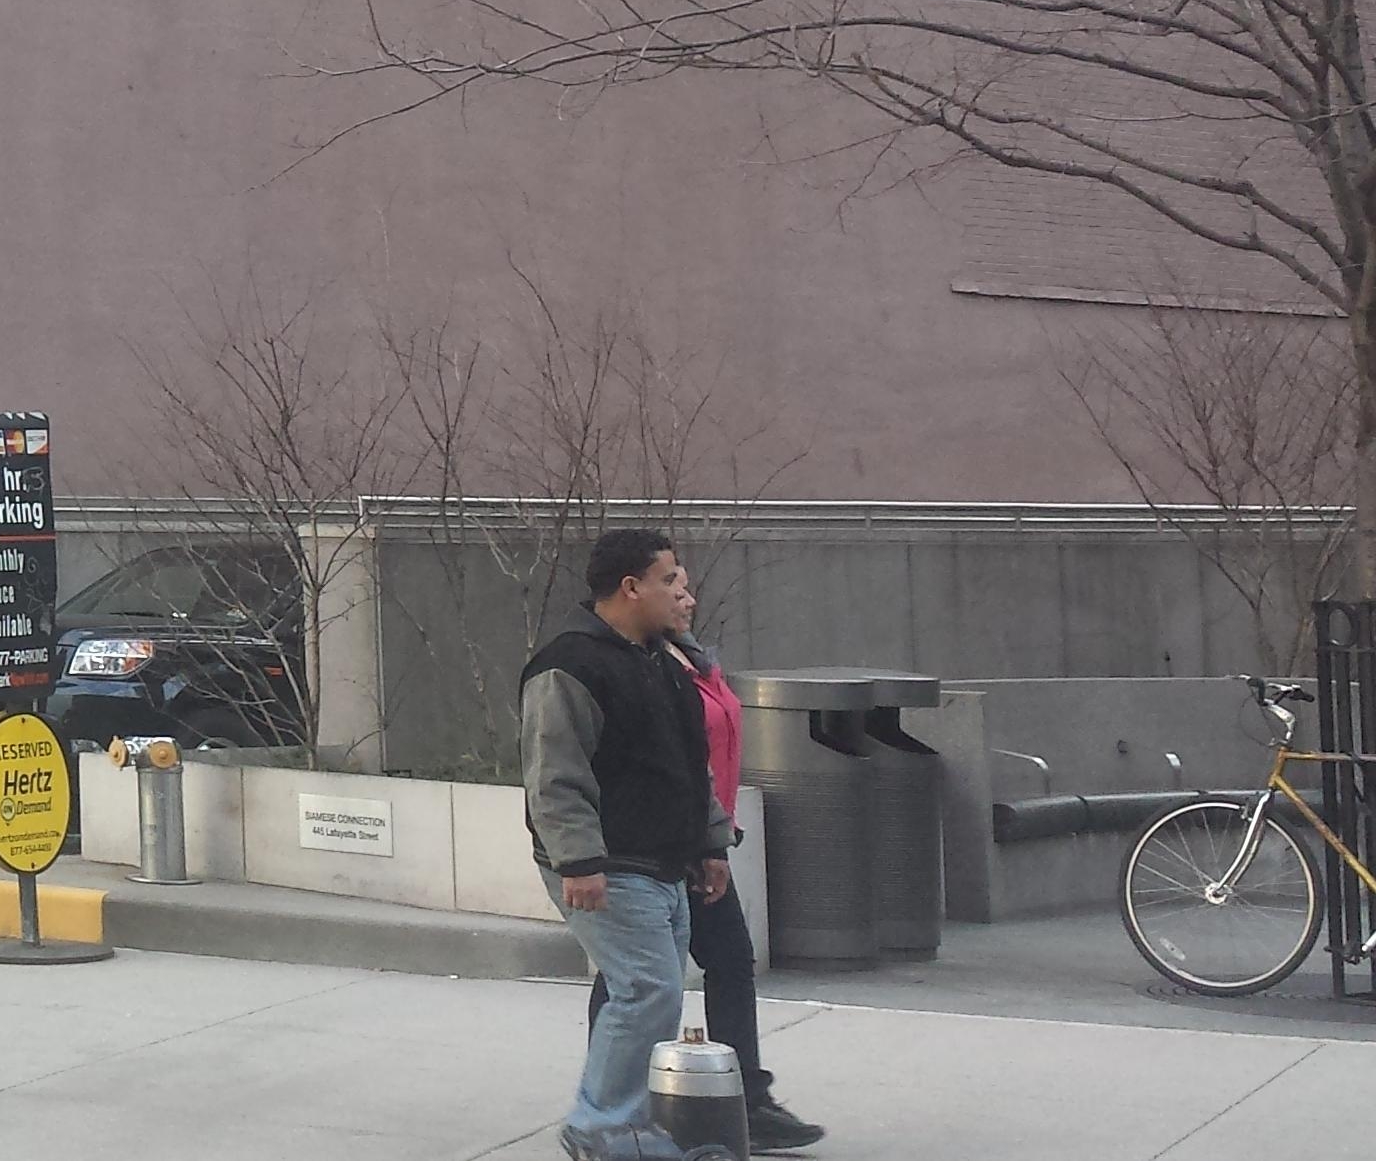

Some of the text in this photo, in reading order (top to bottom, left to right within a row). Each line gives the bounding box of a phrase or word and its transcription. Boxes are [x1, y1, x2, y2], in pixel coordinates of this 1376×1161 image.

[3, 466, 27, 491] hr.
[4, 768, 53, 796] Hertz
[16, 797, 52, 815] Demand
[305, 811, 386, 827] SIAMESE CONNECTION
[326, 828, 357, 839] Lafayette
